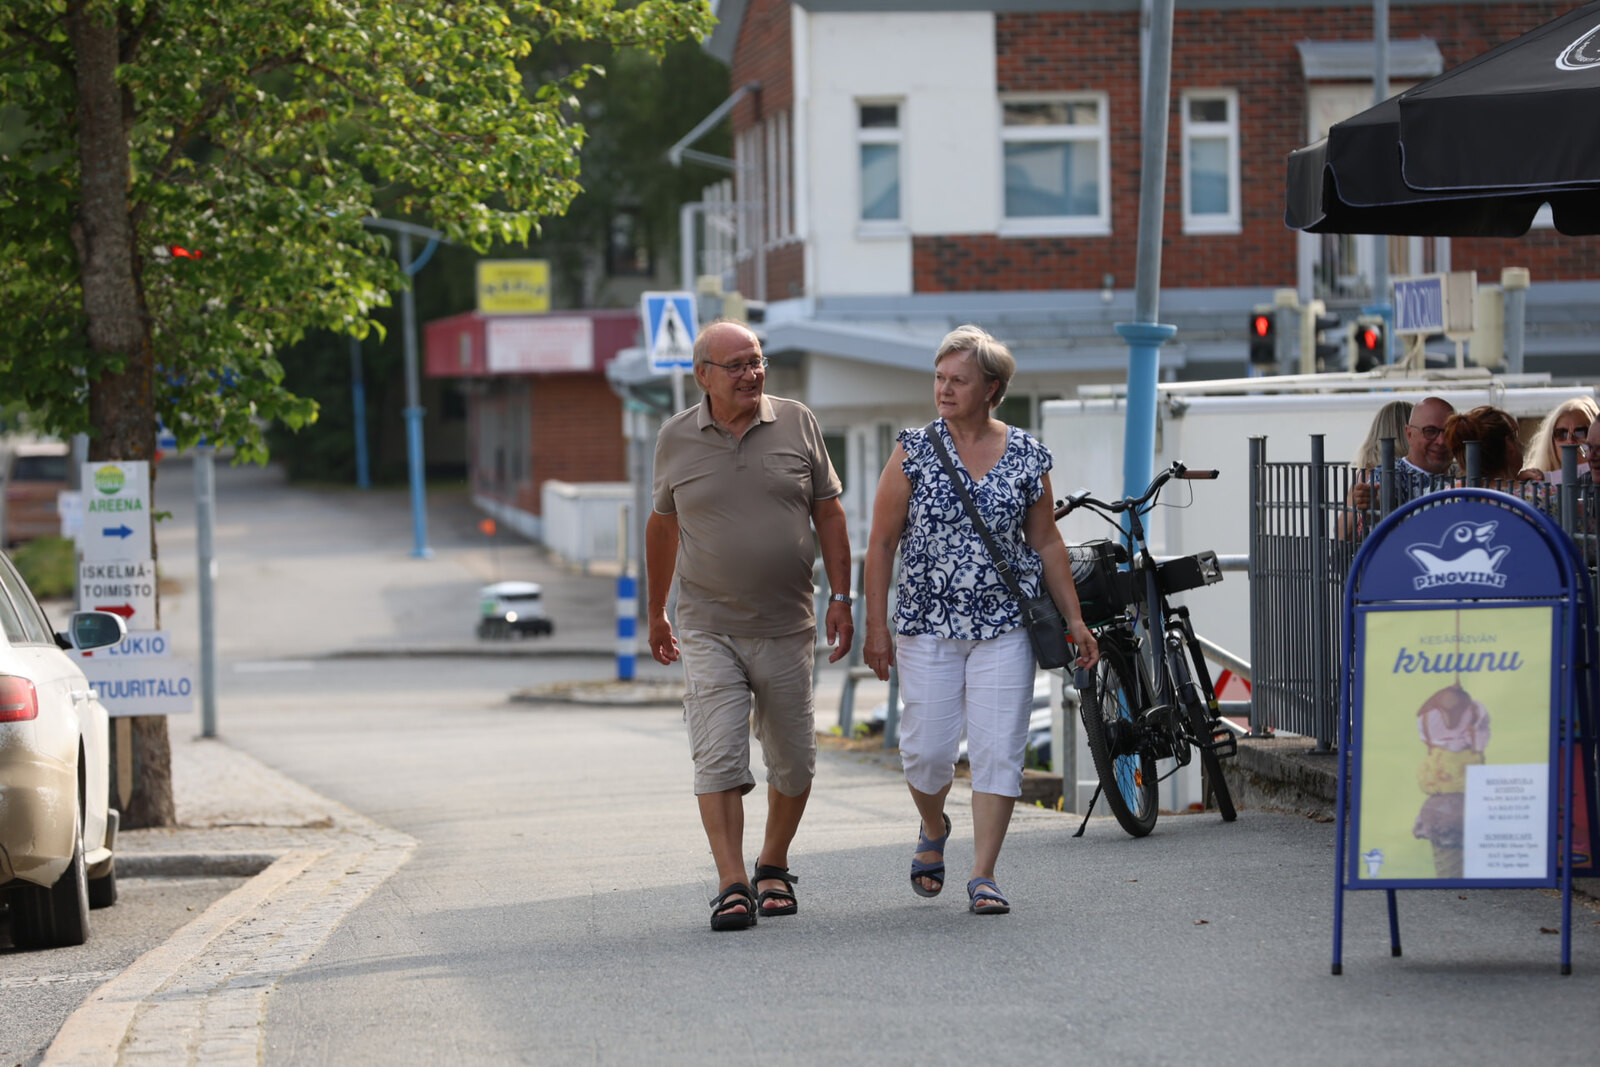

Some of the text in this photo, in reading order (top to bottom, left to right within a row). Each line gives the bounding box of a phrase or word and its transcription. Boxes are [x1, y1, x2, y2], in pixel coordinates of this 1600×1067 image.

[88, 499, 143, 512] AREENA
[82, 563, 151, 579] ISKELMÄ-
[1413, 571, 1508, 591] PINGVIINI
[84, 584, 152, 598] TOIMISTO
[1392, 647, 1525, 674] kruunu
